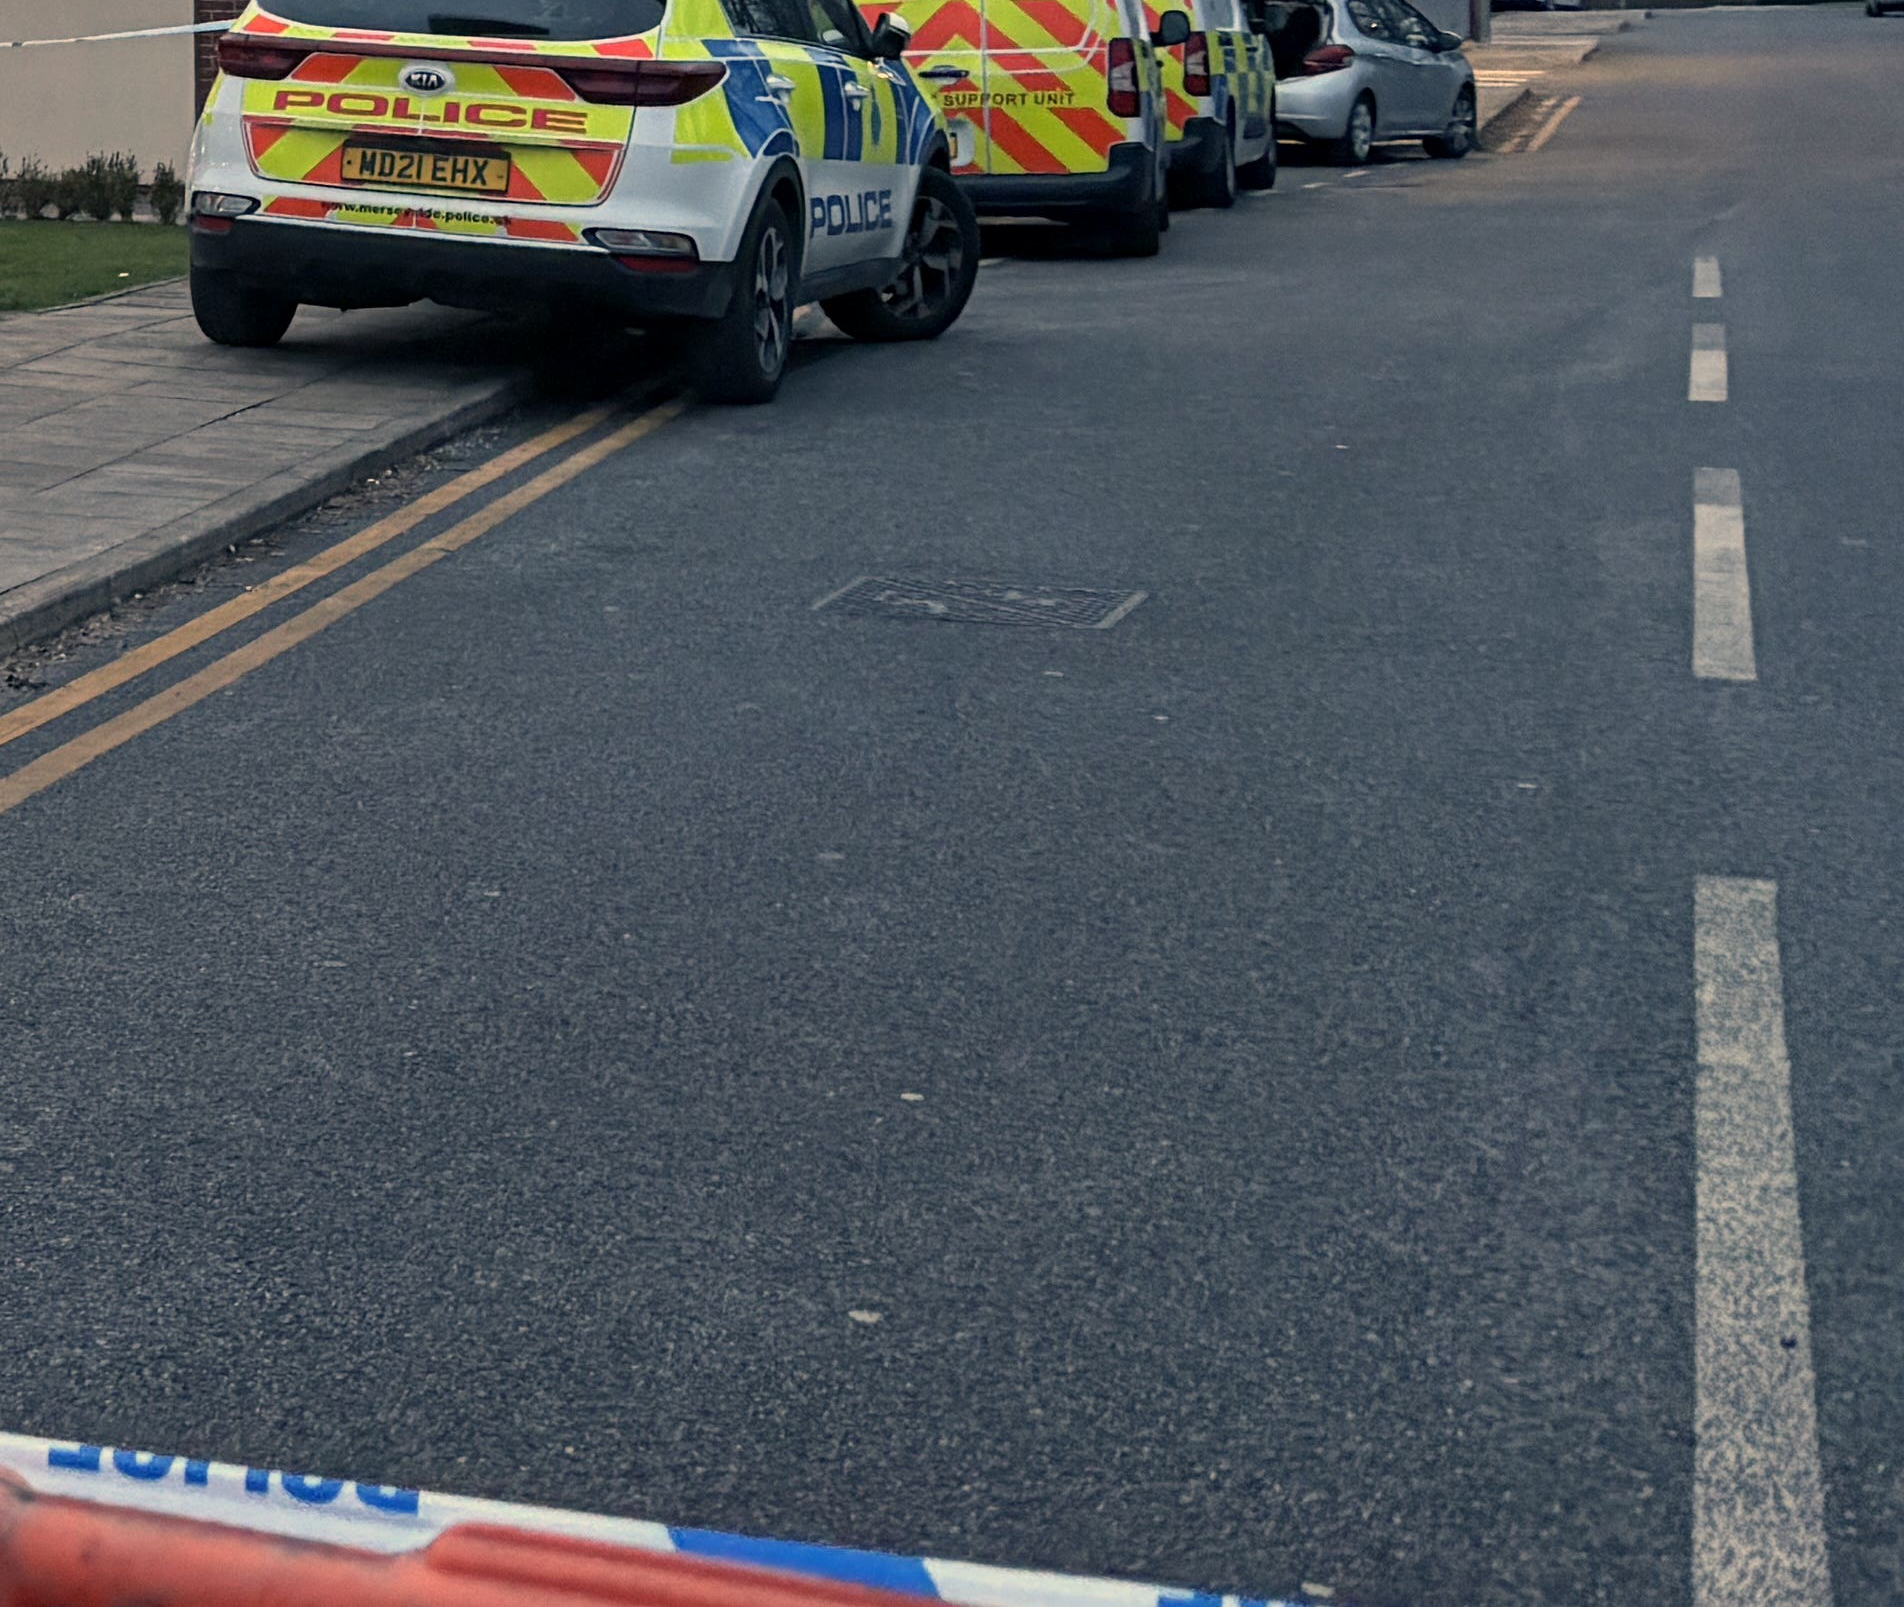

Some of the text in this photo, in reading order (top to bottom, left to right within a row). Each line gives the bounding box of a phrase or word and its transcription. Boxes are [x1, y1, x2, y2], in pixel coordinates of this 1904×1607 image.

[409, 72, 439, 88] KIA
[273, 89, 588, 133] POLICE
[943, 90, 1075, 107] SUPPORT UNIT
[359, 150, 489, 186] MD21 EHX
[810, 189, 893, 239] POLICE
